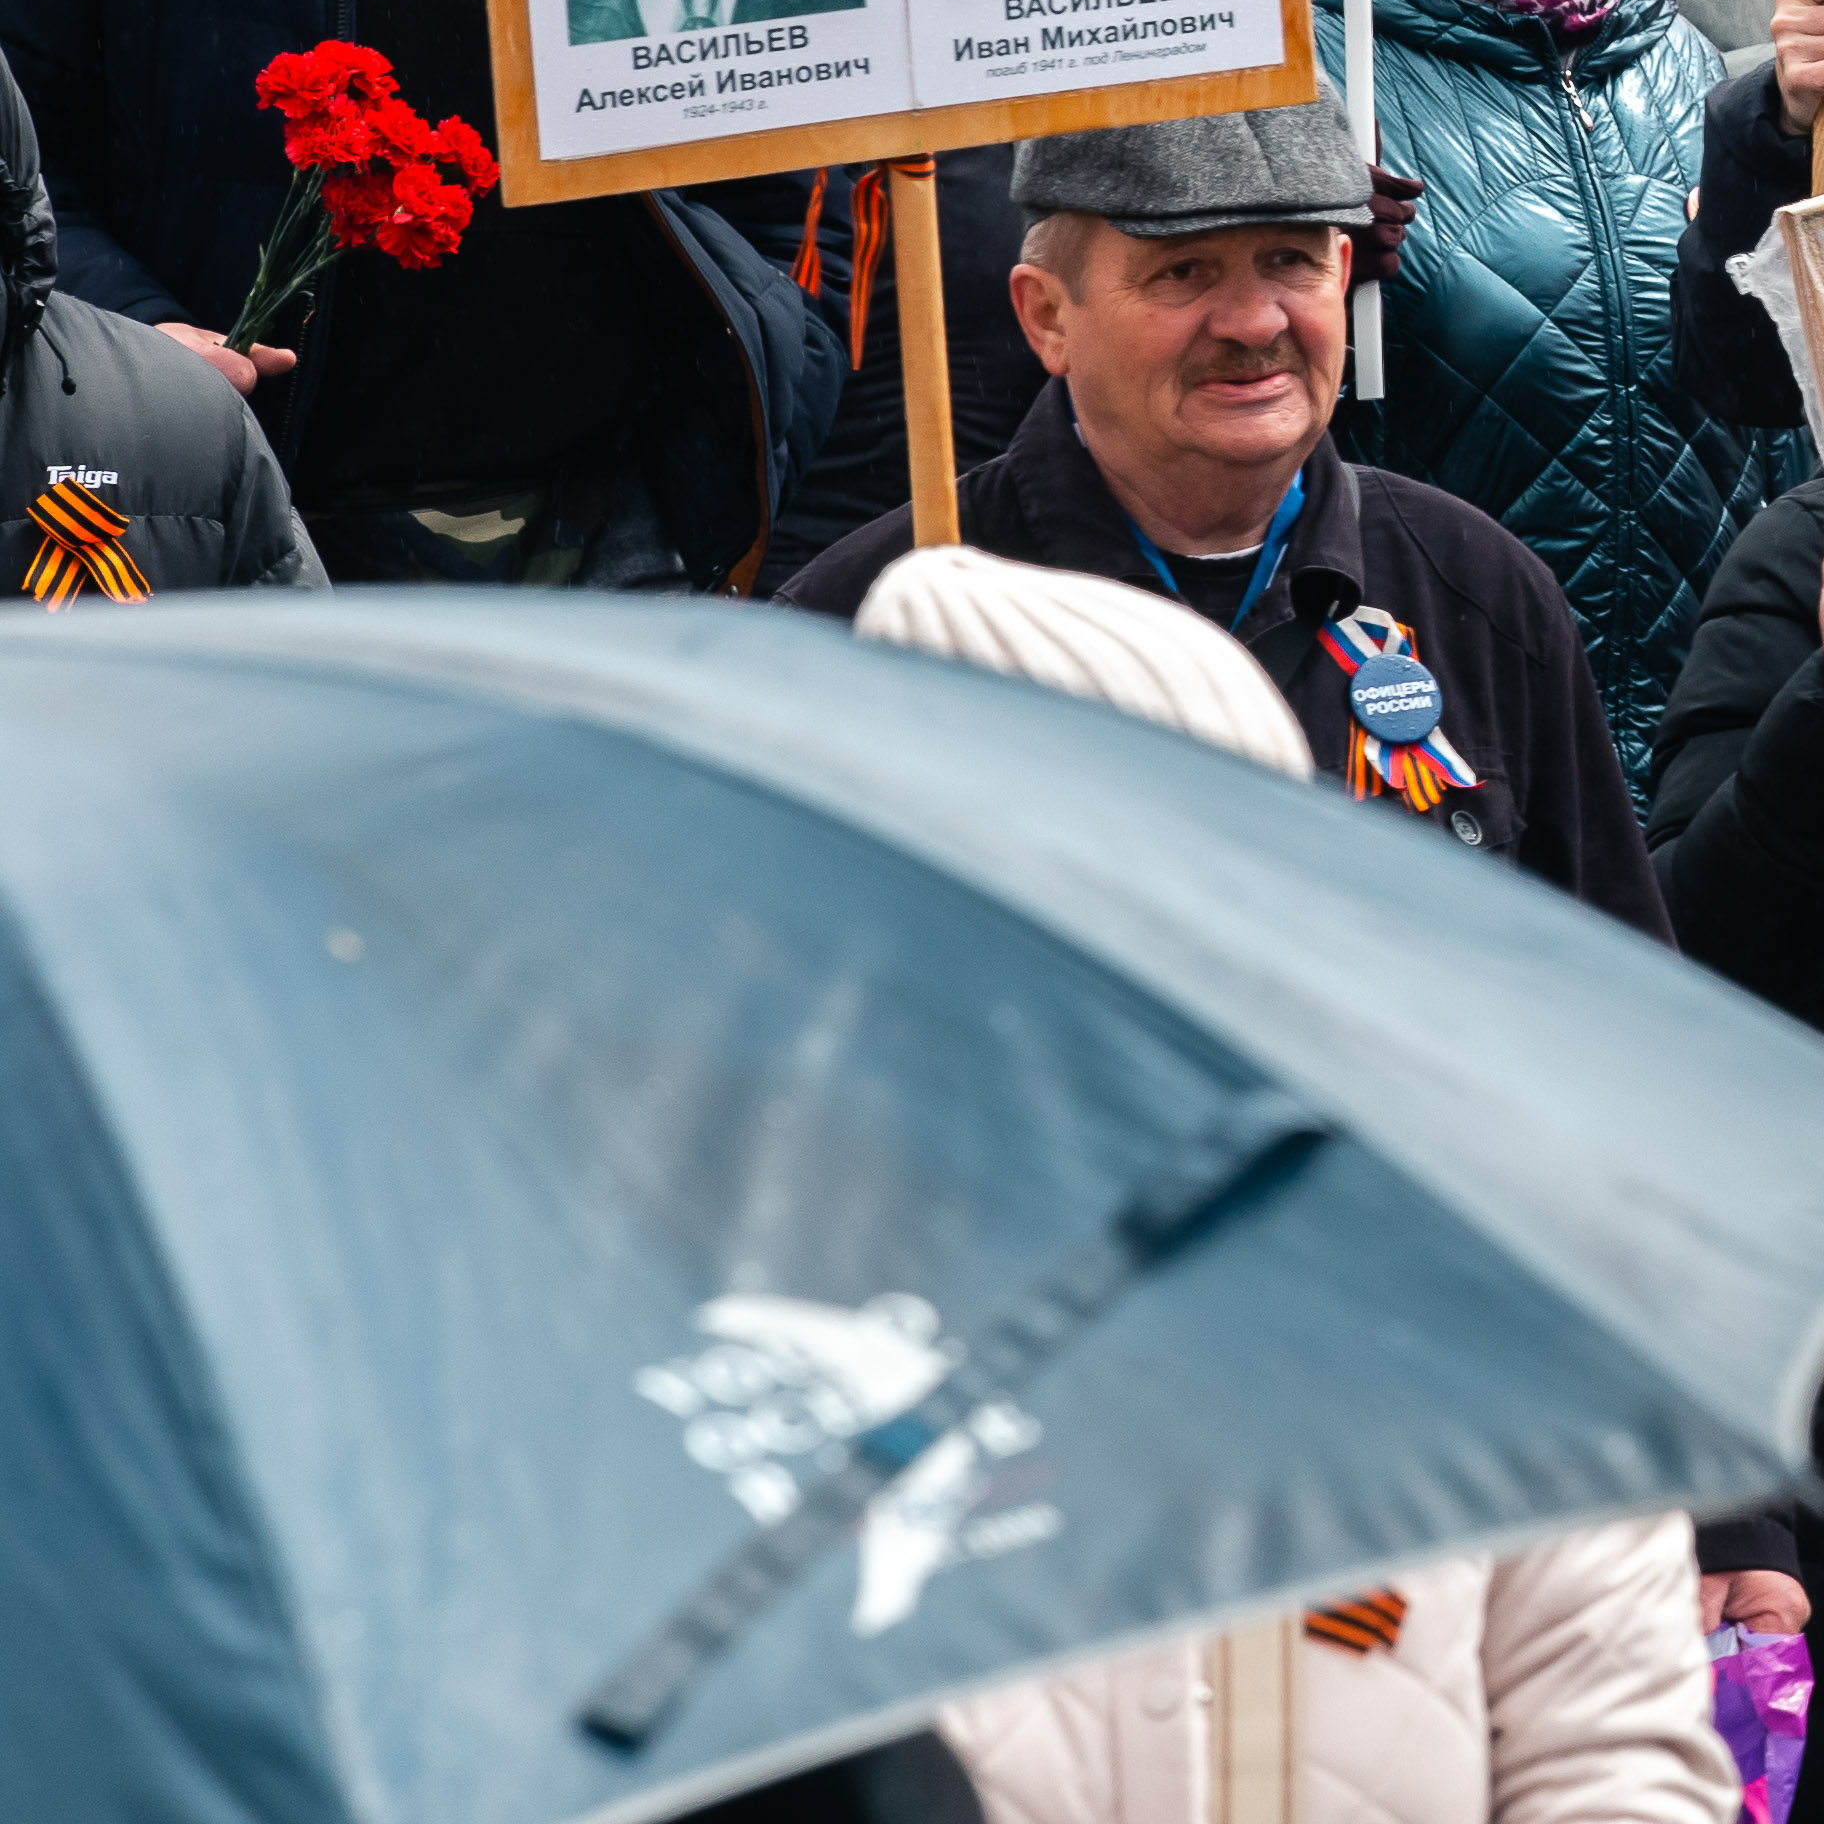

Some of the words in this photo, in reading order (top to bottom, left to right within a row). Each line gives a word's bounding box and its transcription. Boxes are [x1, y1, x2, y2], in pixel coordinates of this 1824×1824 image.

[631, 24, 811, 71] ВАСИЛЬЕВ
[952, 32, 1032, 64] Иван
[1038, 8, 1236, 53] Михайлович
[1031, 57, 1065, 74] 1941
[1111, 37, 1209, 66] Ленинградом
[575, 70, 708, 115] Алексей
[714, 54, 872, 96] Иванович
[682, 101, 753, 121] 1924-1943
[46, 464, 119, 489] Taiga
[1354, 680, 1437, 702] ОФИЦЕРЫ
[1366, 696, 1433, 715] РОССИИ
